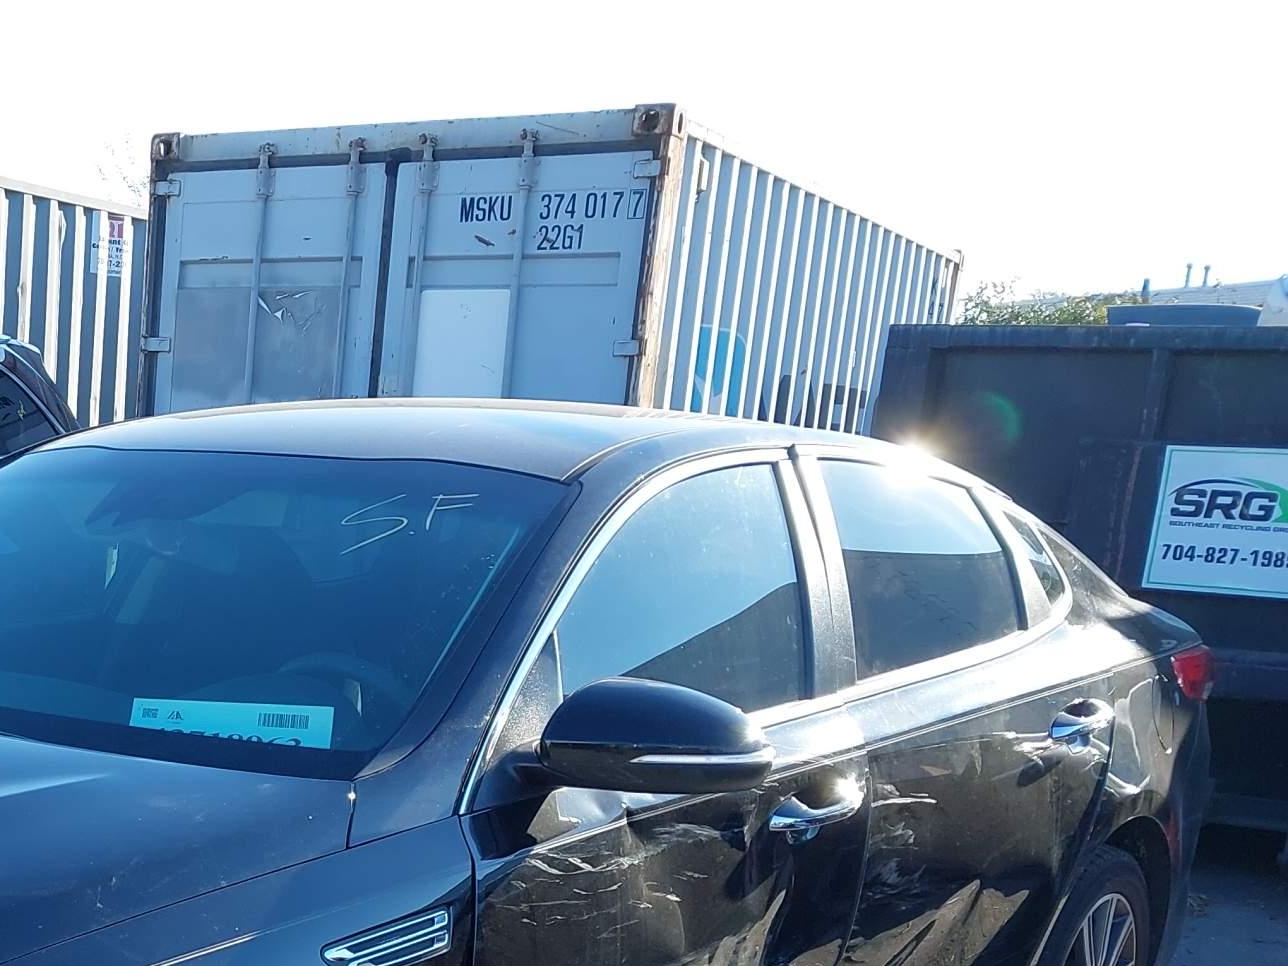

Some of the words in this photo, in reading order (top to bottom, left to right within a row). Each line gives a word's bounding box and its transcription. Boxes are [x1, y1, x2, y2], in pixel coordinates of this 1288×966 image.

[460, 196, 512, 222] MSKU
[540, 193, 576, 220] 374
[584, 191, 624, 218] 017
[537, 224, 584, 250] 22G1
[1170, 488, 1279, 522] SRG
[1169, 520, 1220, 529] SOUTHEAST
[1222, 523, 1271, 532] RECYCLING
